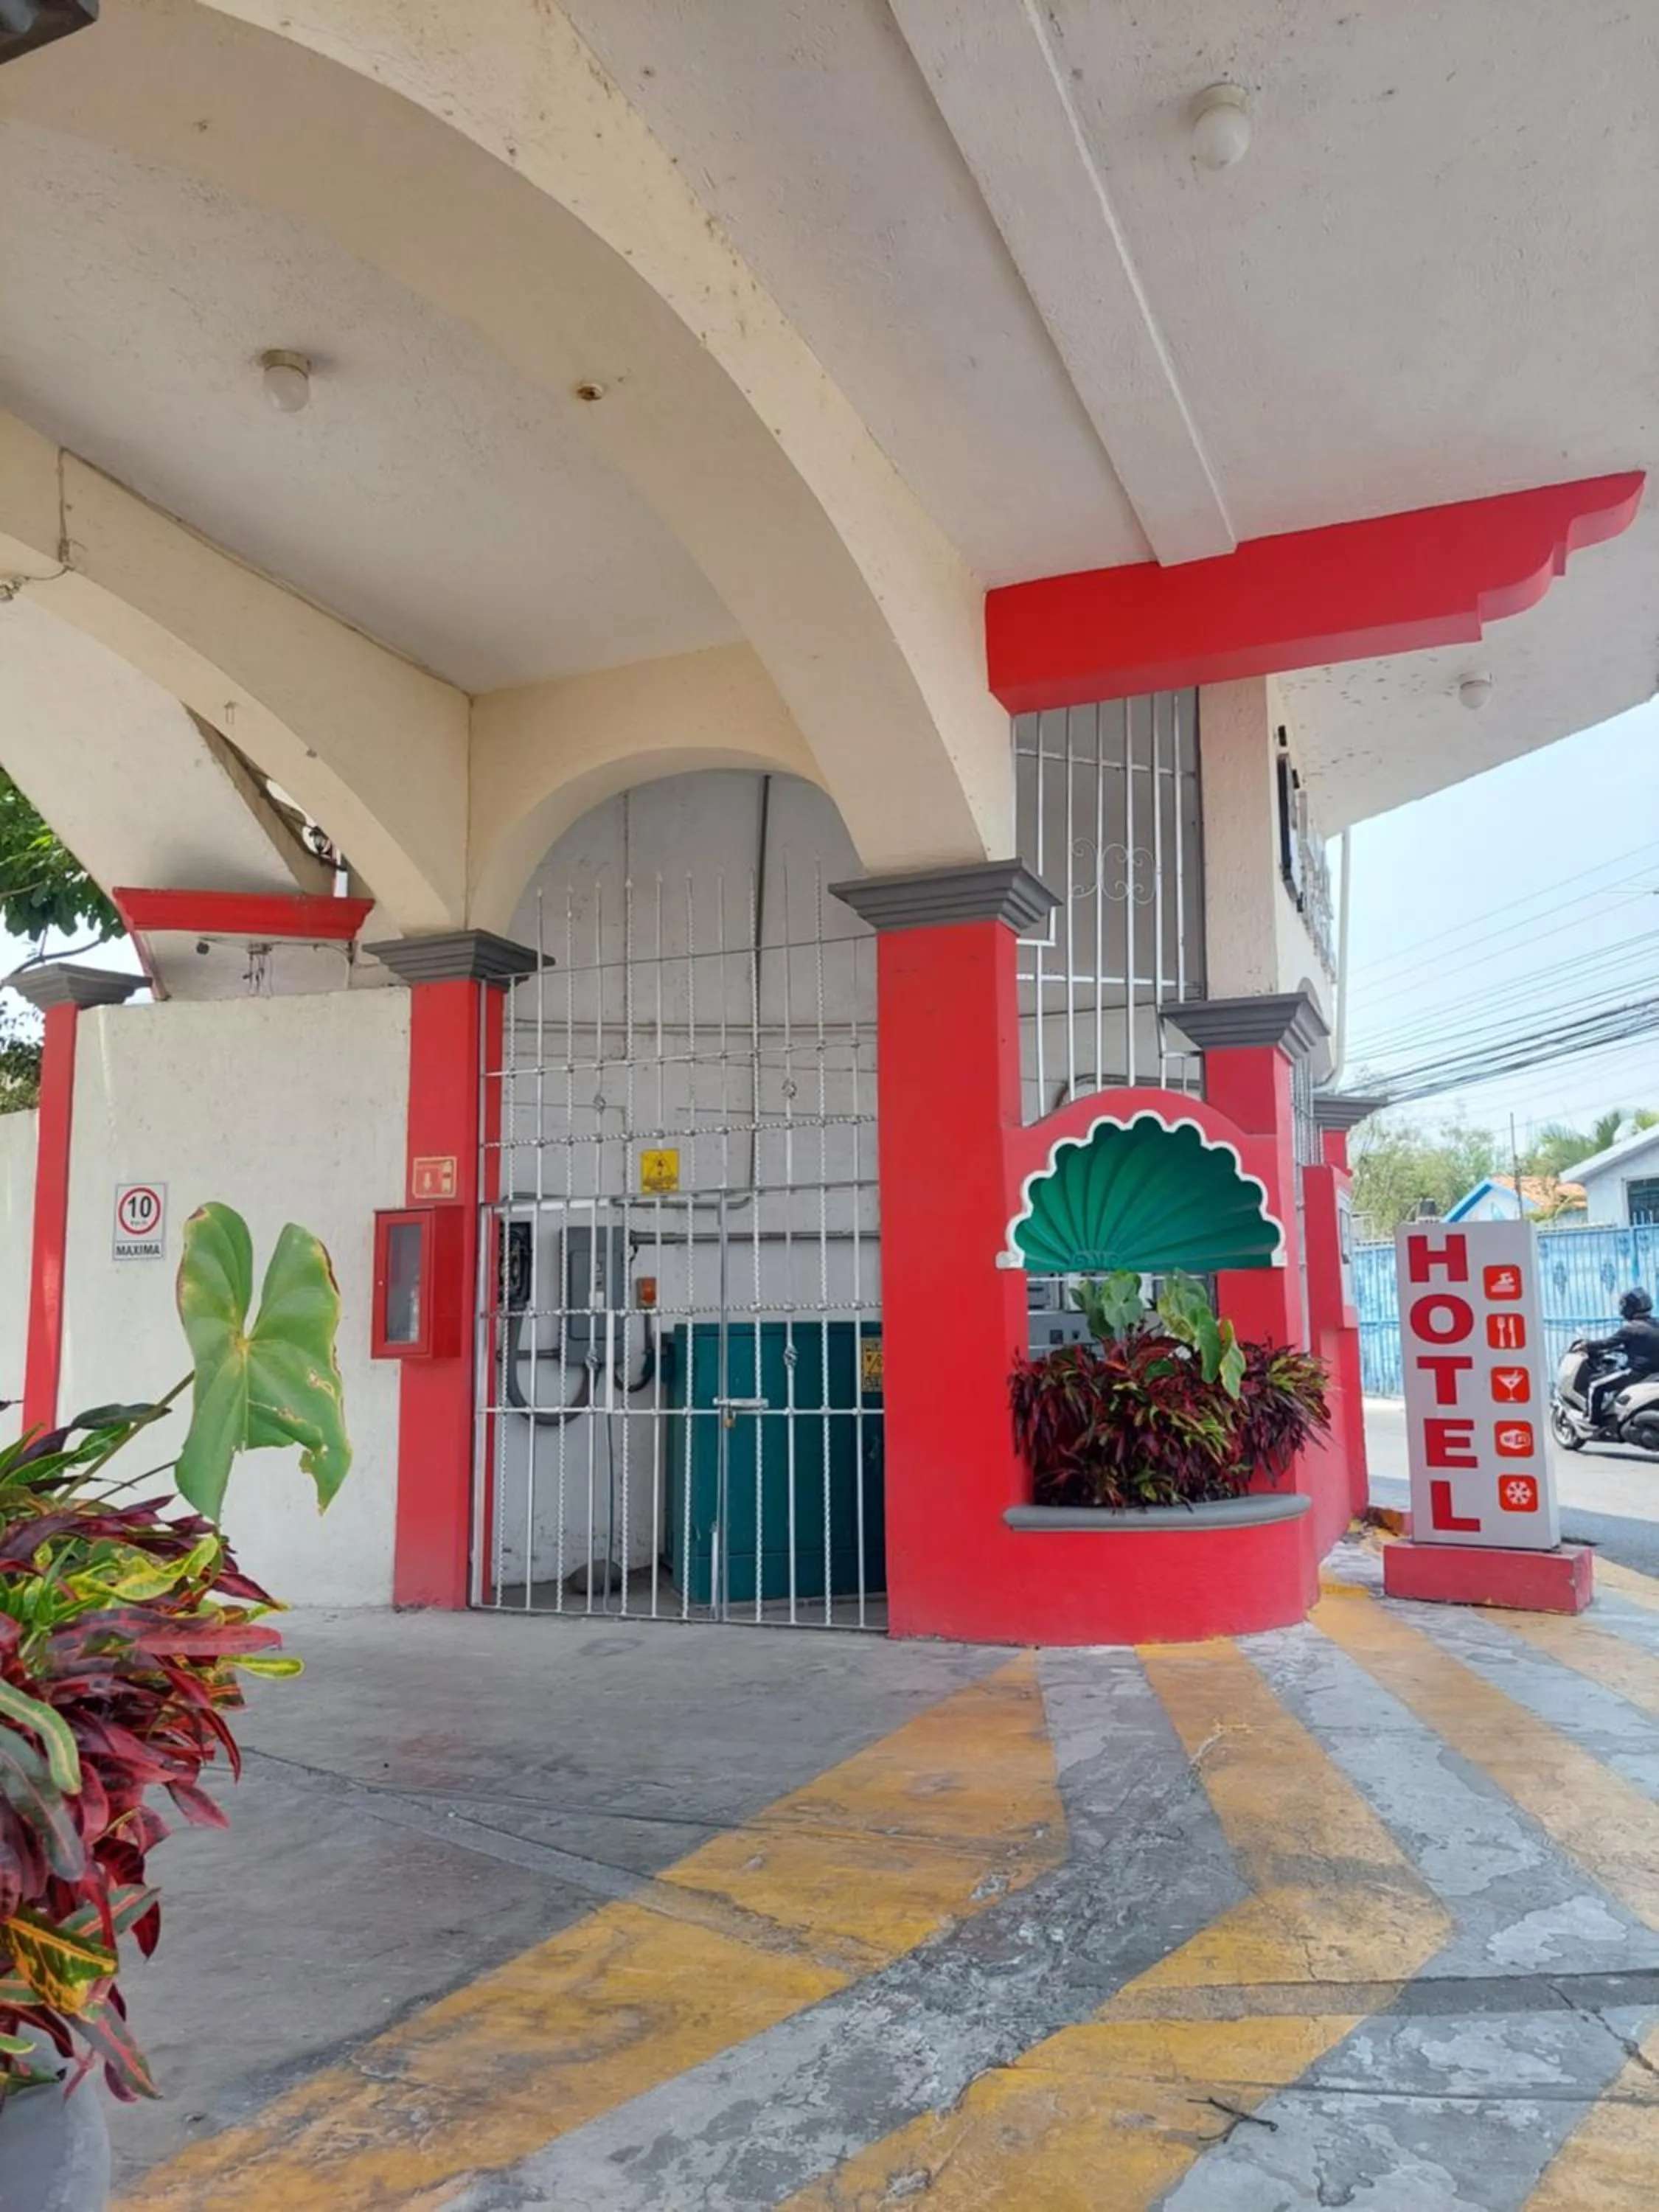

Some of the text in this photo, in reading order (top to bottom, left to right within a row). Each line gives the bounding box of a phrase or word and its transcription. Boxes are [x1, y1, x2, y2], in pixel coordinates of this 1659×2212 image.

[128, 1195, 152, 1218] 10
[116, 1244, 160, 1256] MAXIMA
[1407, 1234, 1481, 1533] HOTEL
